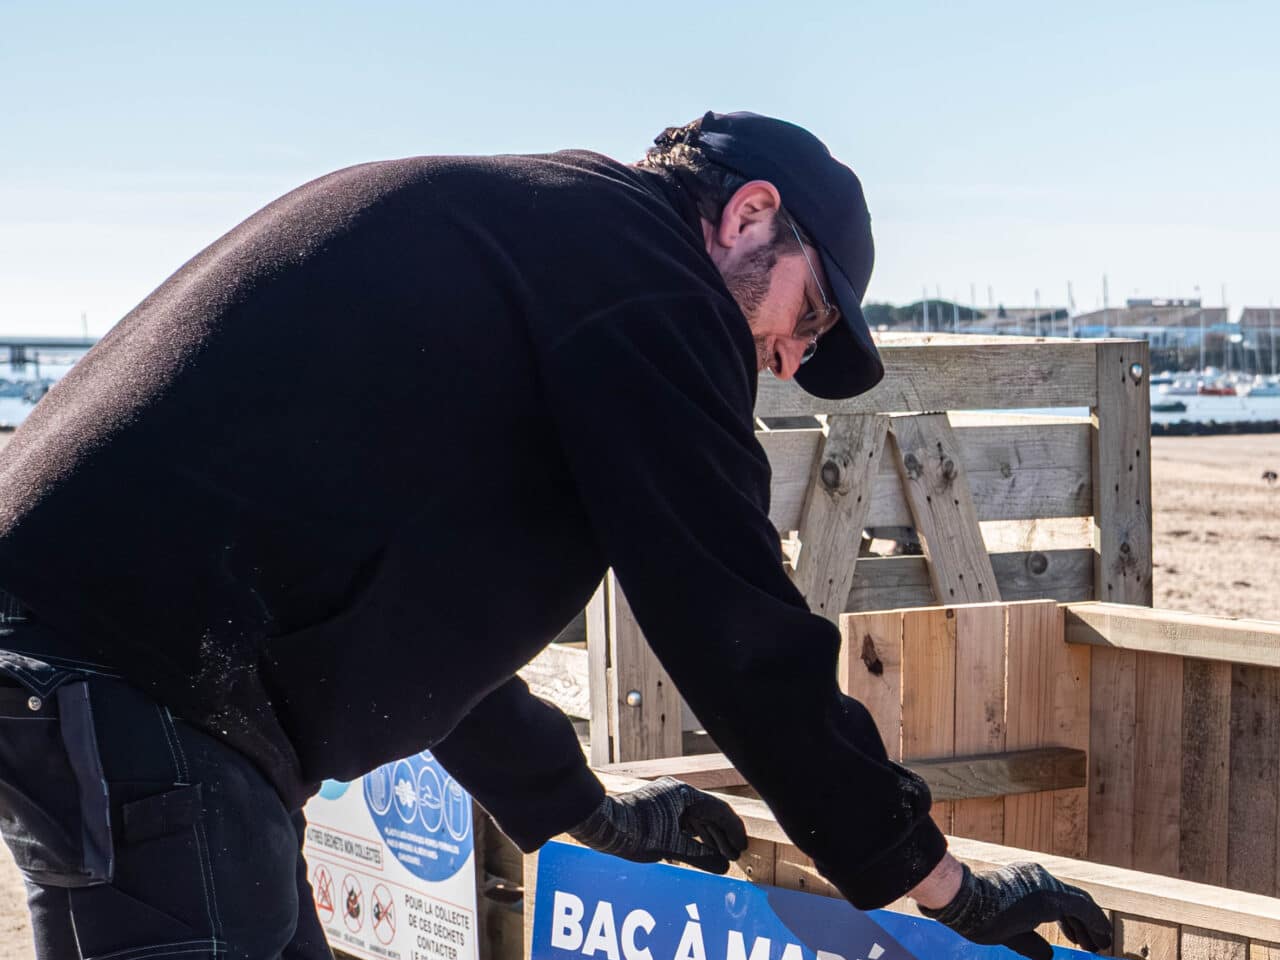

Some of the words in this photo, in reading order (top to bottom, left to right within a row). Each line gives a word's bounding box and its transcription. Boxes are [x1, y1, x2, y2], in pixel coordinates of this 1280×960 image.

[405, 894, 422, 911] POUR
[424, 902, 432, 915] LA
[435, 905, 470, 930] COLLECTE
[408, 913, 417, 928] DE
[419, 917, 431, 934] CES
[417, 935, 458, 960] CONTACTER
